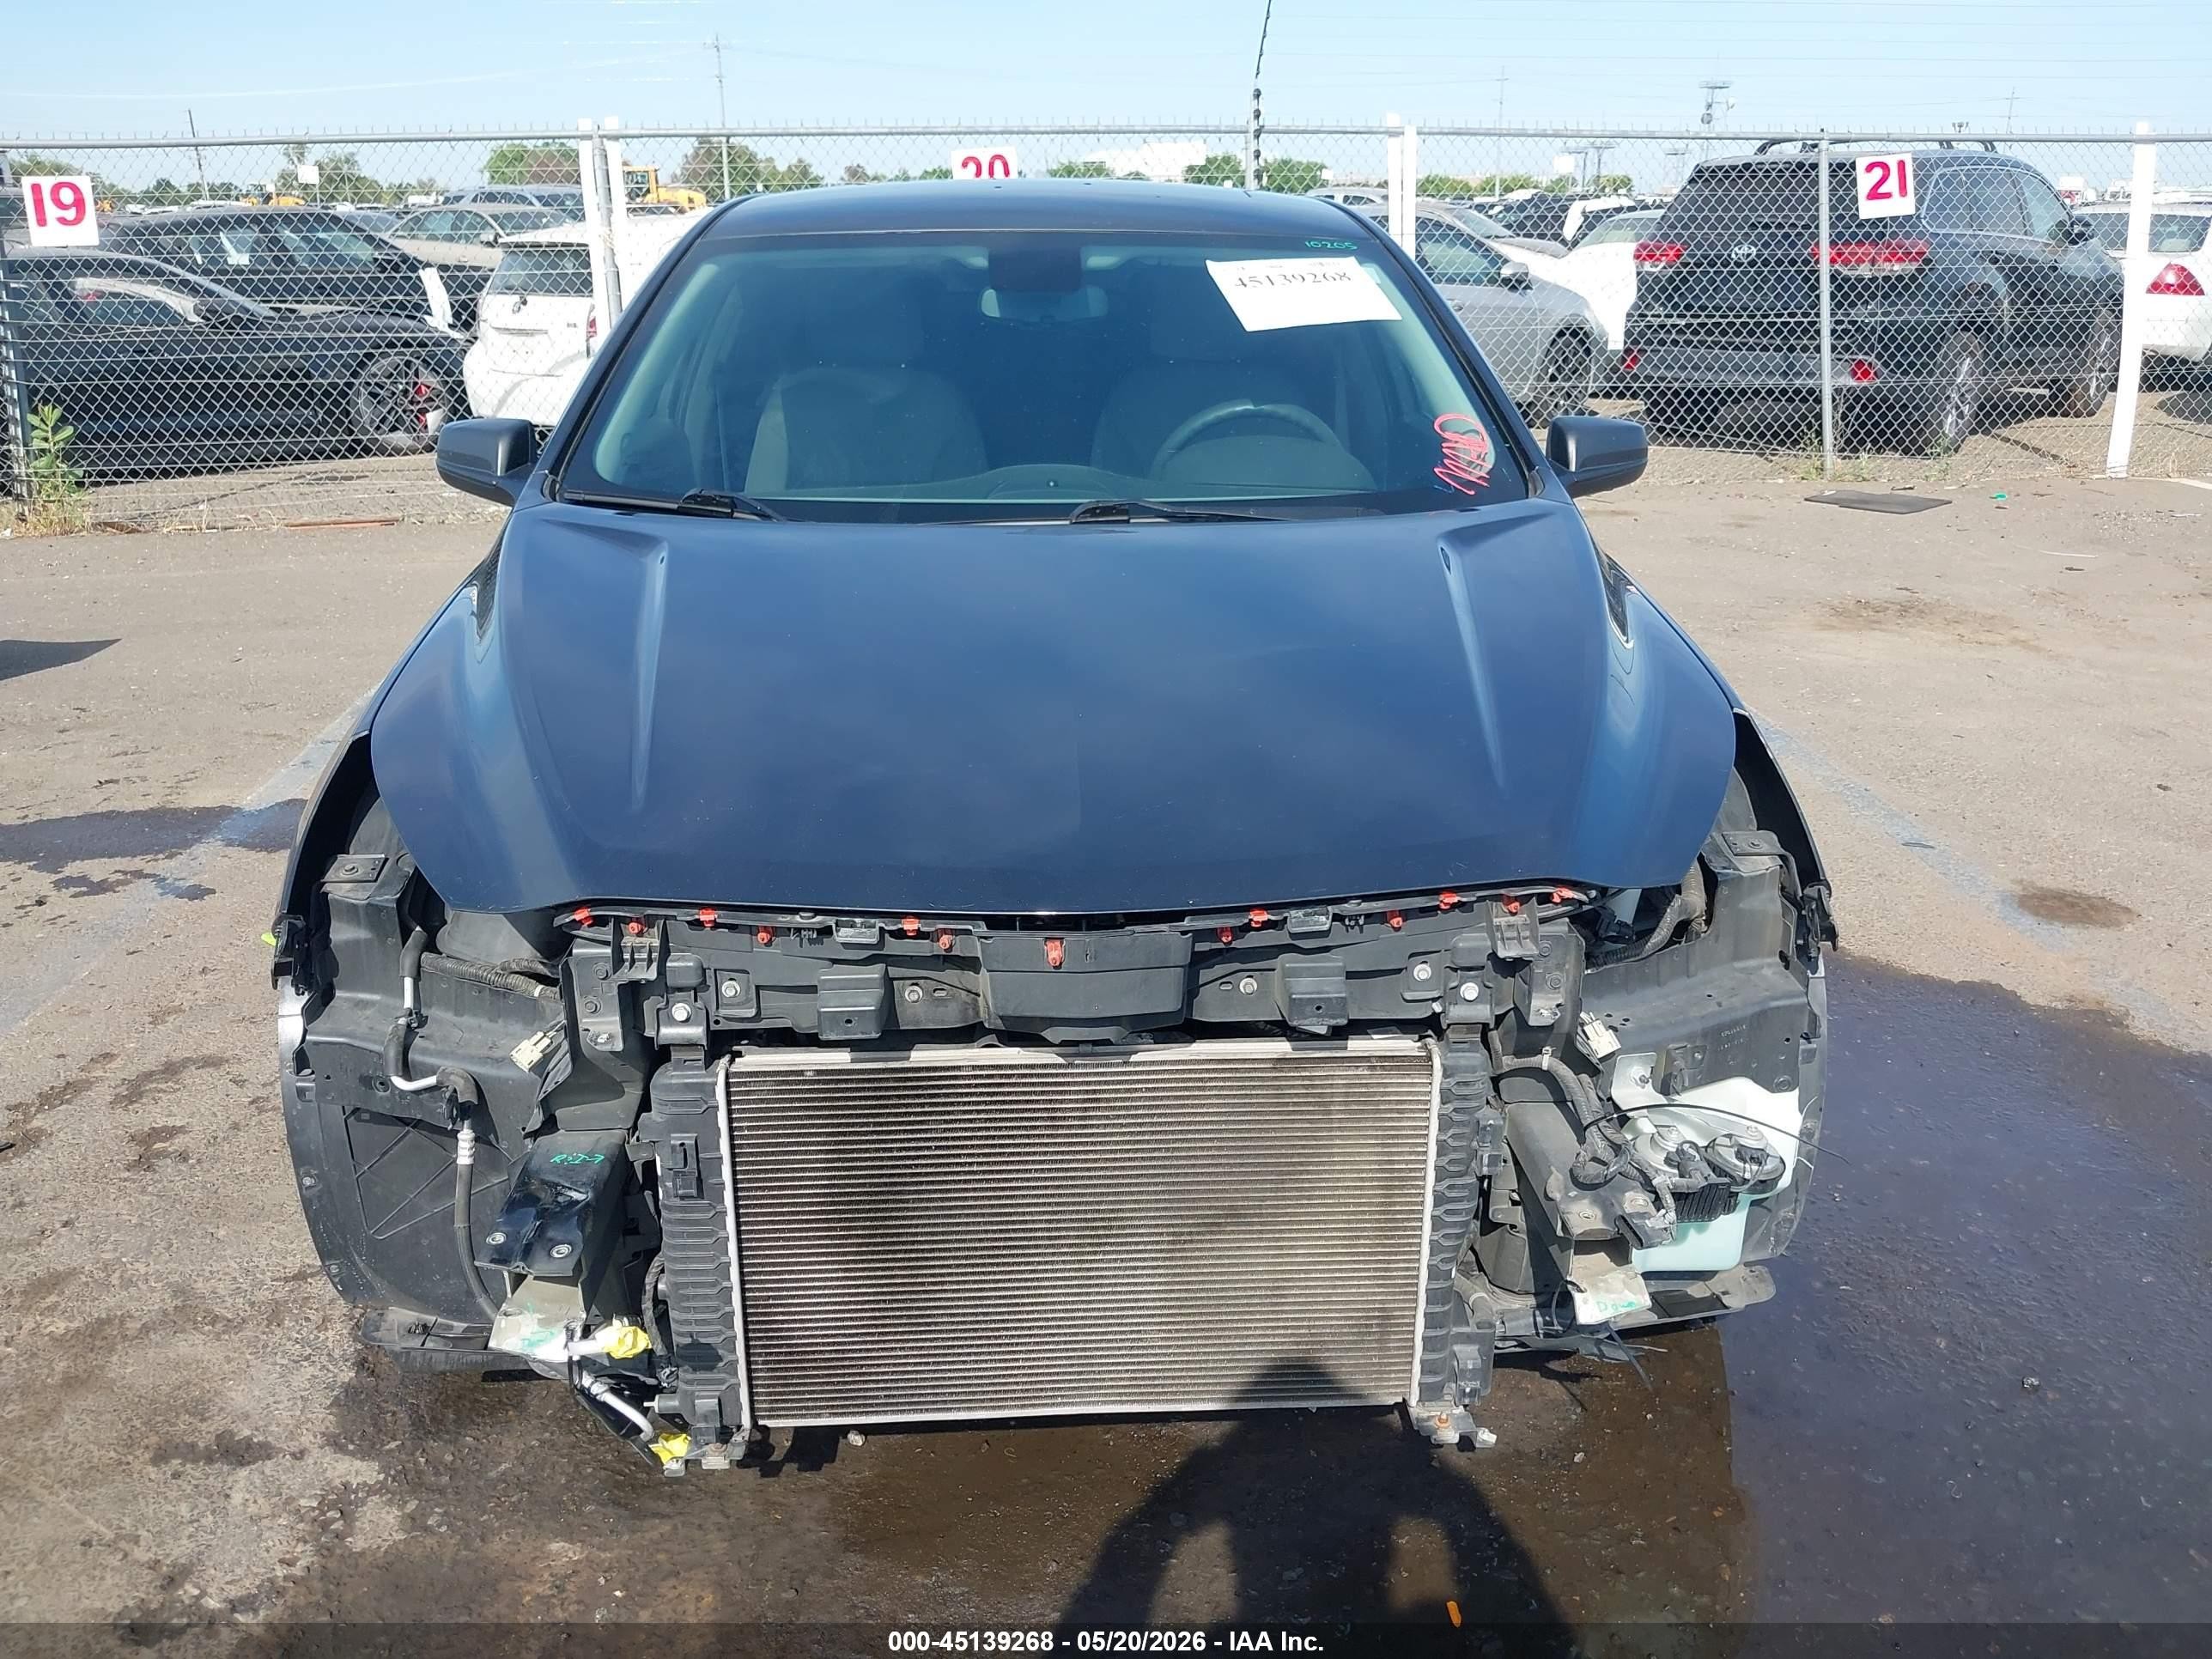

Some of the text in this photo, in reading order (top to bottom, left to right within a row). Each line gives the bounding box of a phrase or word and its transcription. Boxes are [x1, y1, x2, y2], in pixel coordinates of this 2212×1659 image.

[1864, 160, 1907, 200] 21
[31, 181, 86, 227] 19
[1235, 271, 1352, 289] 45139268
